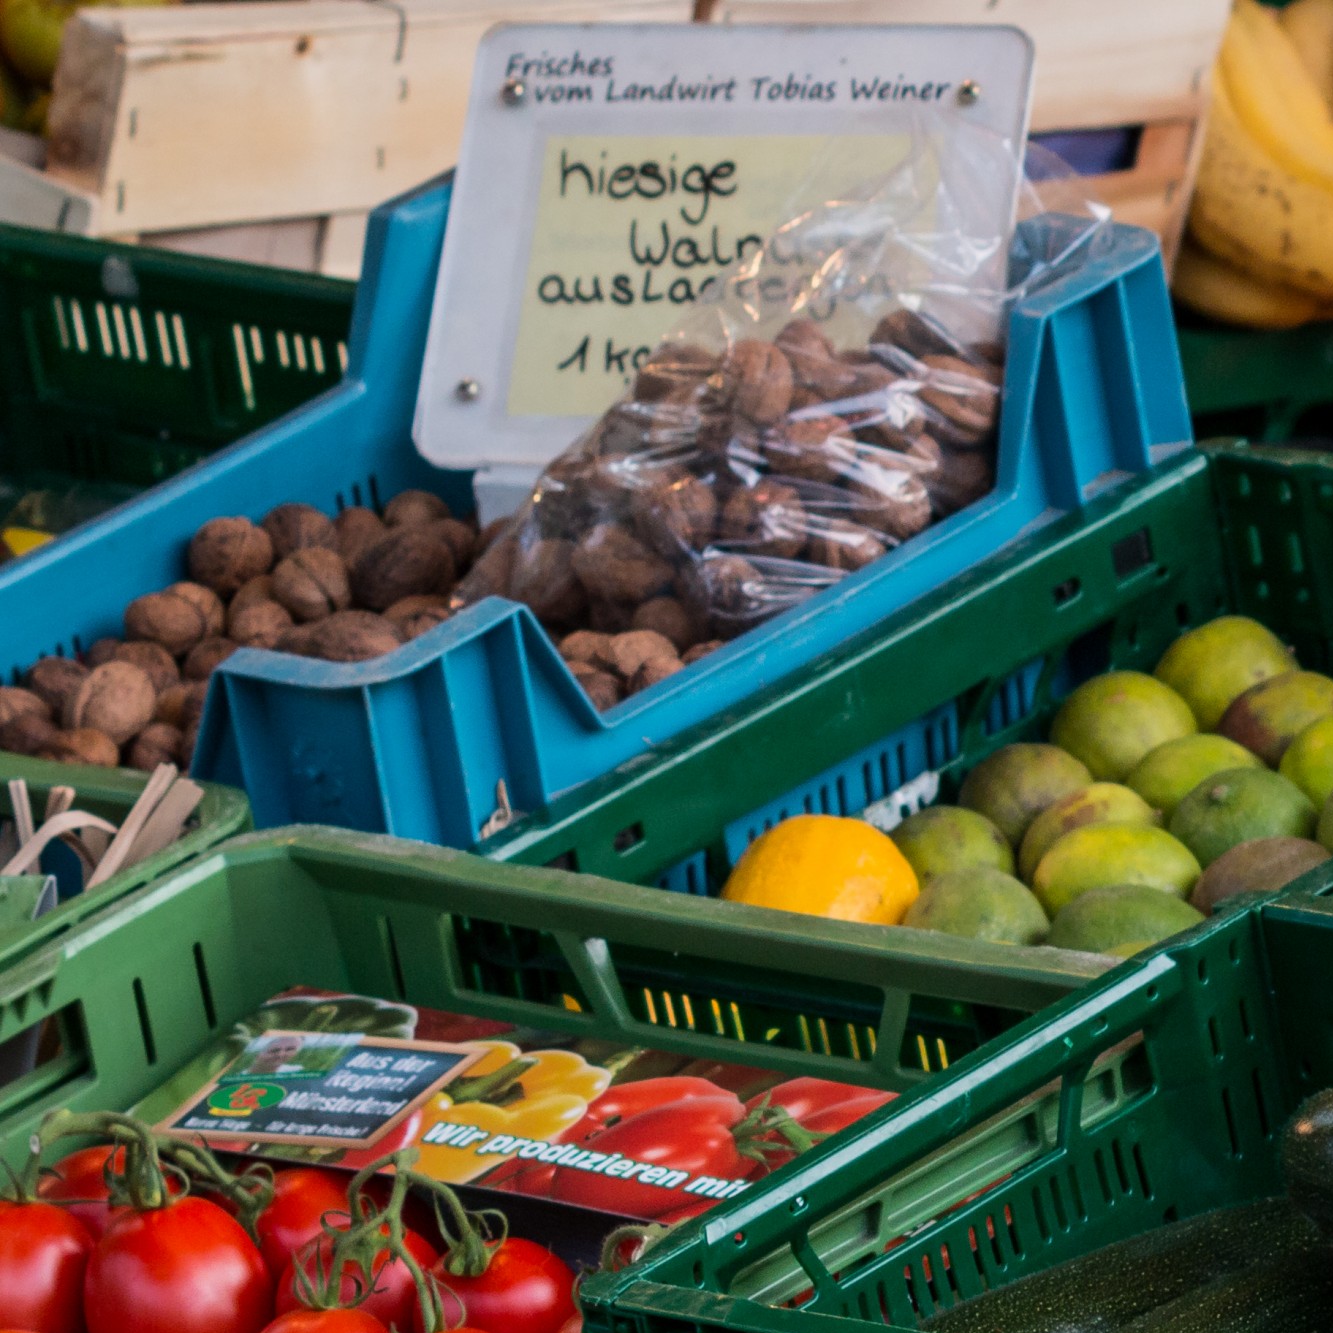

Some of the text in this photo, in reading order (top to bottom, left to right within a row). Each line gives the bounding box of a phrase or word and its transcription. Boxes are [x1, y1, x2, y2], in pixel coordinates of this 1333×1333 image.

[505, 52, 614, 79] Frisches
[534, 75, 950, 104] vom Landwirt Tobias Weiner
[560, 149, 737, 225] hiesige
[556, 334, 590, 373] 1
[346, 1051, 436, 1074] Aus der
[278, 1090, 409, 1116] Münsterland
[423, 1120, 489, 1149] Wir
[476, 1134, 690, 1188] produzieren
